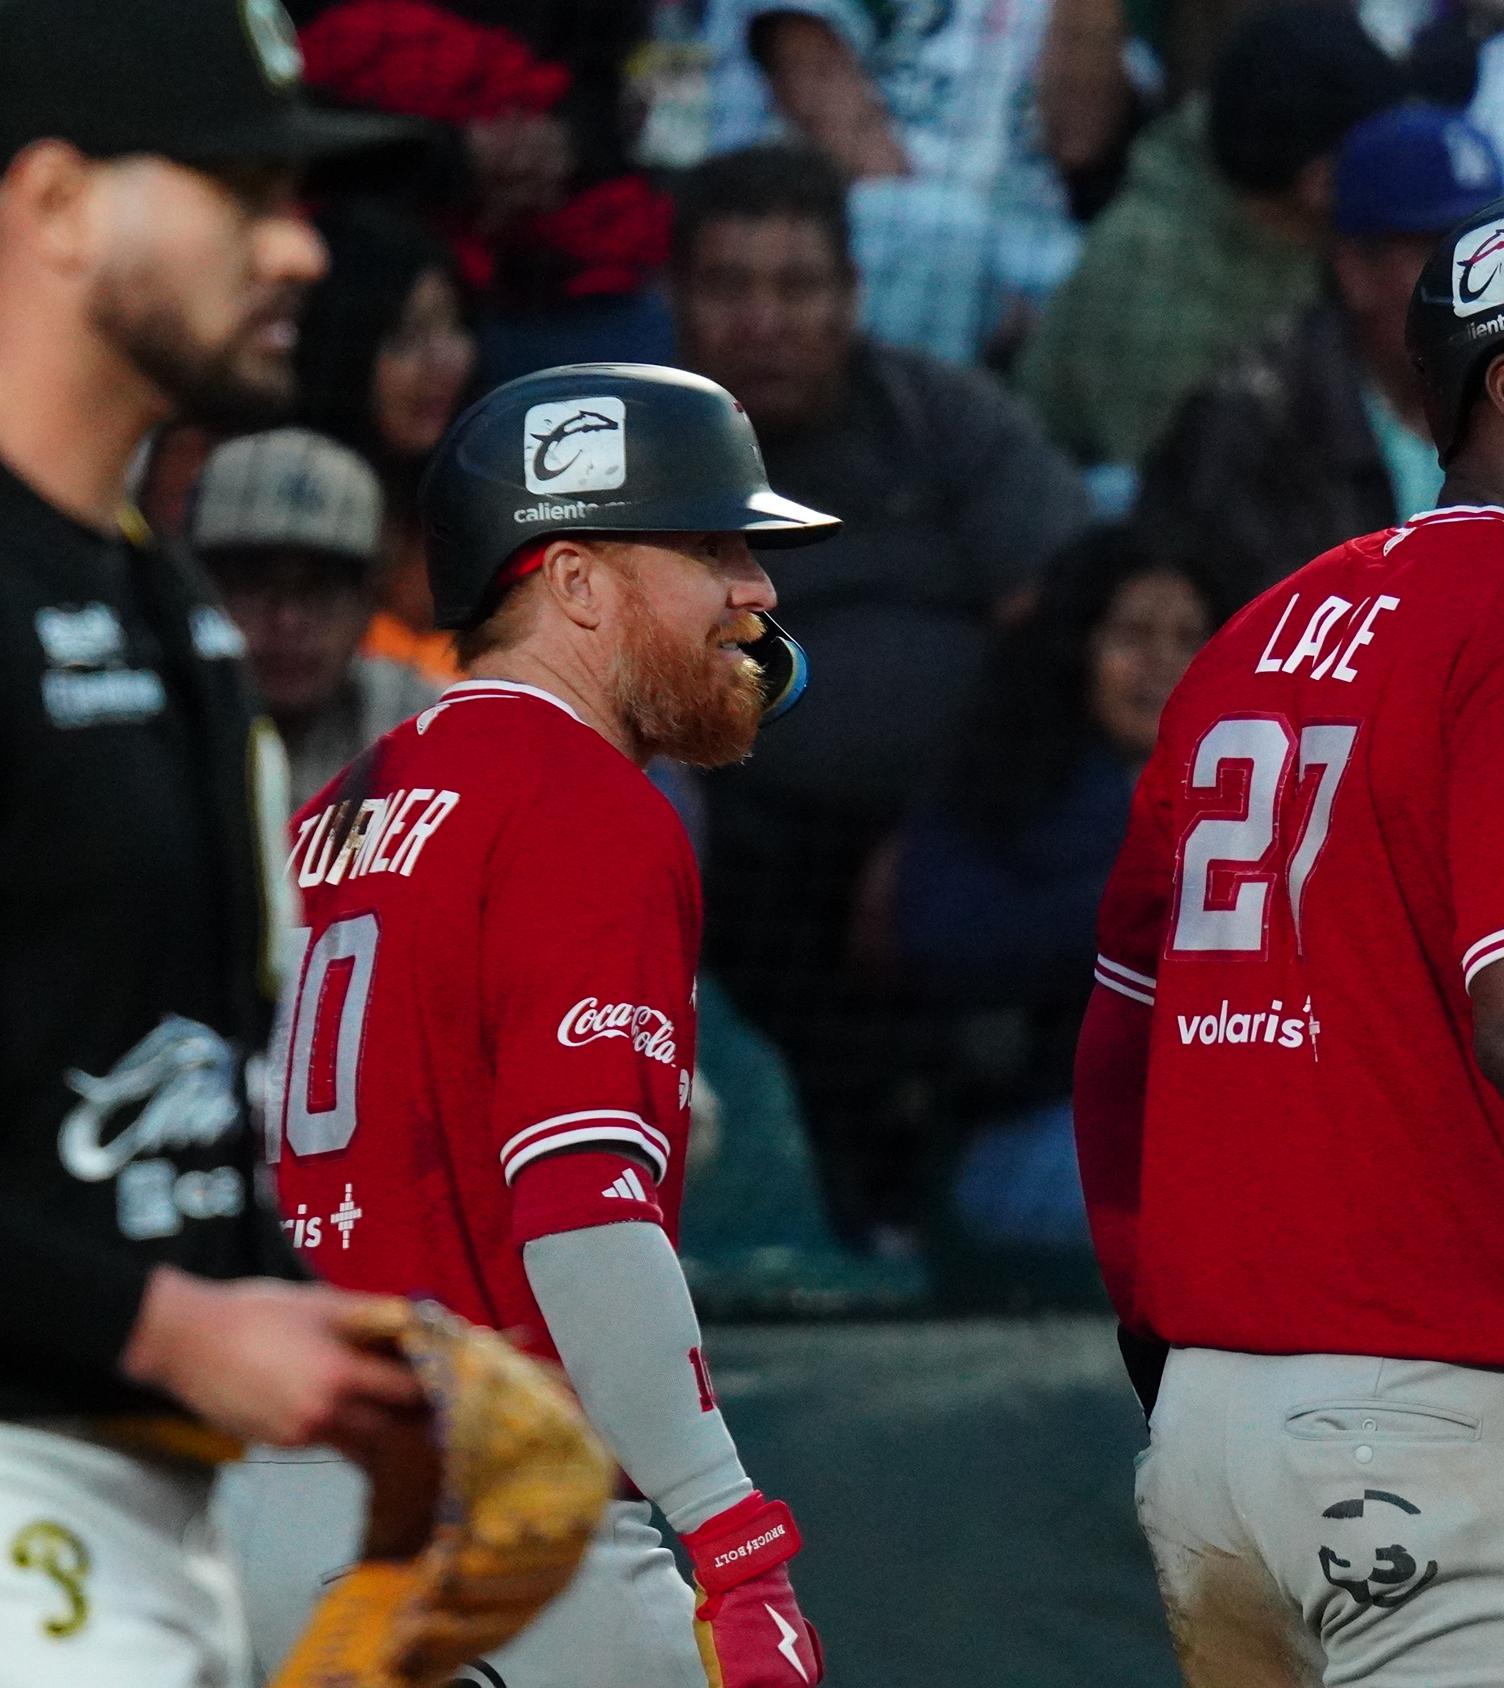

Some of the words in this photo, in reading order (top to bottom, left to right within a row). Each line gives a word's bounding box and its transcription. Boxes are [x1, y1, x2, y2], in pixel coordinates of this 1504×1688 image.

[1254, 592, 1401, 683] LAE
[1172, 718, 1358, 956] 27
[1177, 999, 1305, 1049] volaris
